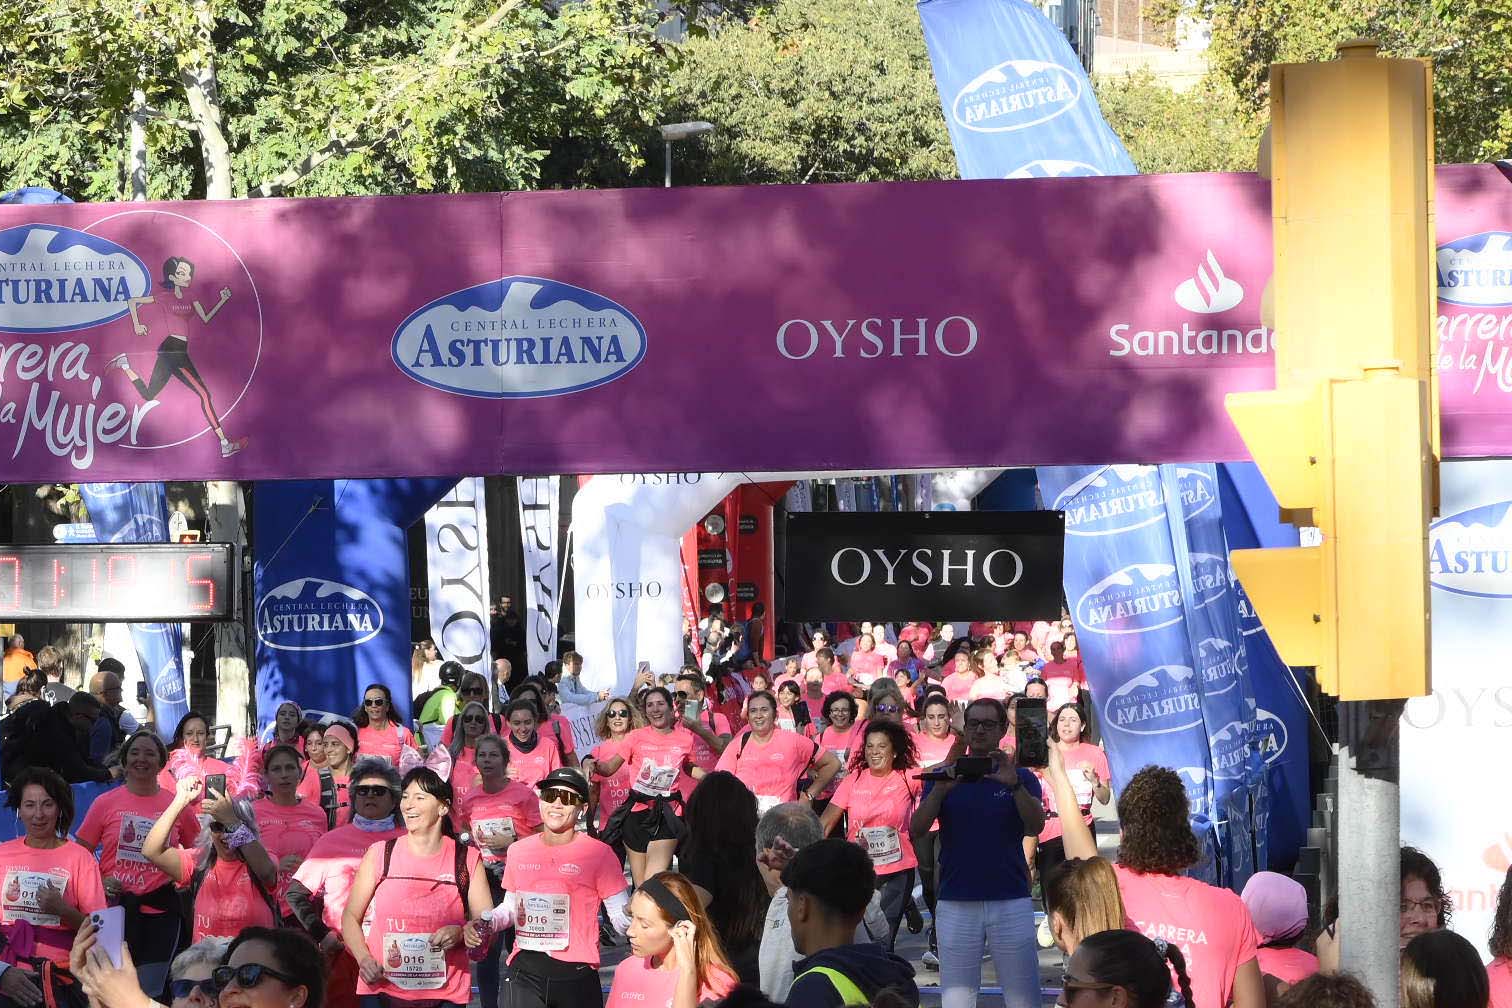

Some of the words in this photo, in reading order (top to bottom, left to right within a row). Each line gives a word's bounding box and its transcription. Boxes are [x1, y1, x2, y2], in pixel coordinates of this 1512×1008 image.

[55, 260, 126, 272] LECHERA
[450, 319, 529, 332] CENTRAL
[537, 317, 619, 329] LECHERA
[411, 324, 628, 369] ASTURIANA
[776, 315, 979, 360] OYSHO
[1462, 349, 1477, 370] la
[12, 382, 162, 470] Mujer
[830, 547, 1024, 588] OYSHO
[585, 581, 662, 601] OYSHO
[261, 607, 374, 635] ASTURIANA
[21, 890, 37, 899] 01
[387, 918, 406, 932] TU
[527, 915, 548, 925] 016
[403, 955, 425, 965] 016
